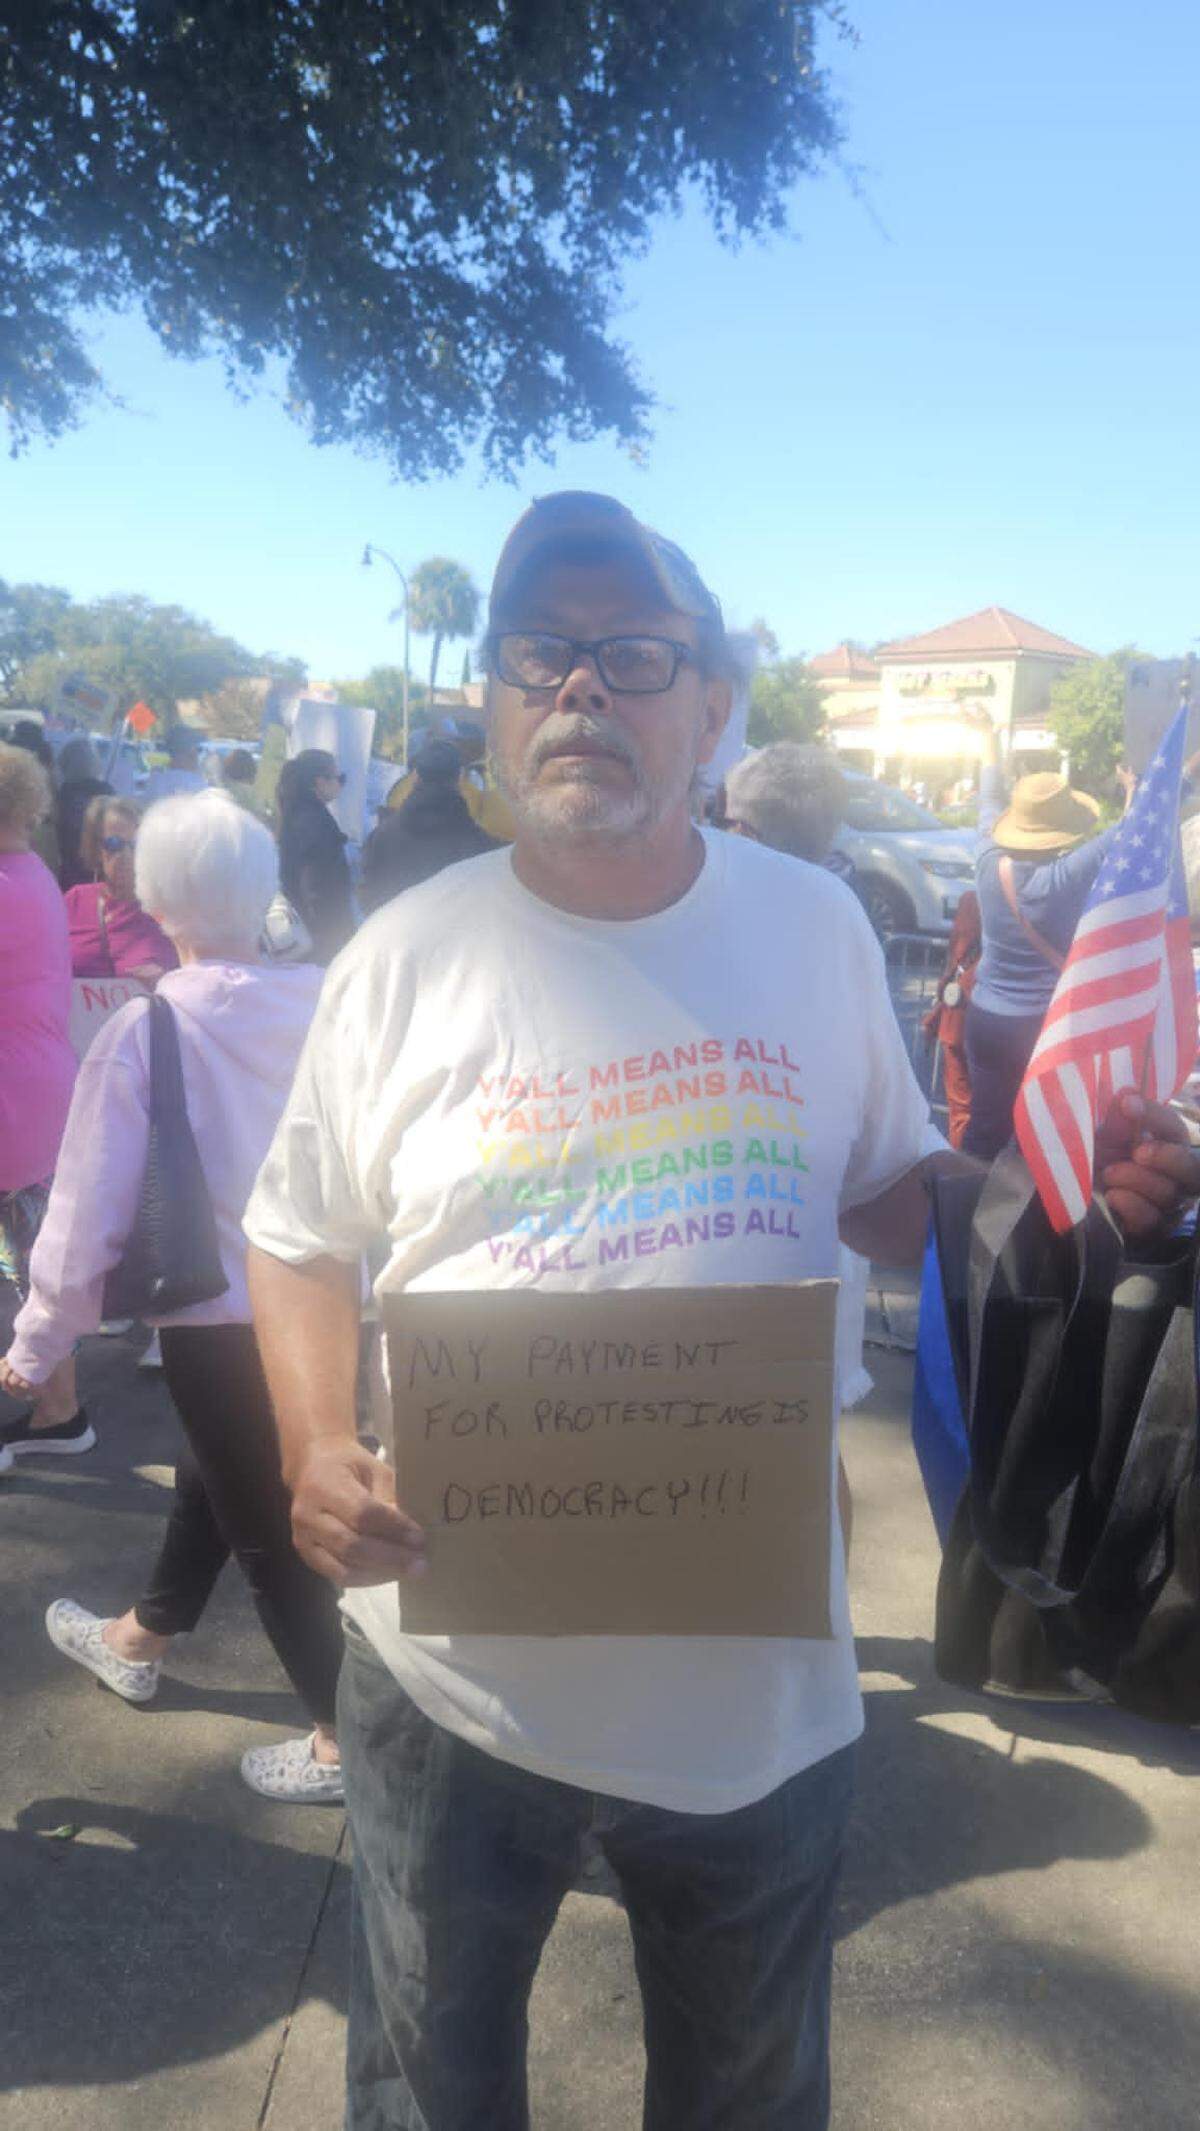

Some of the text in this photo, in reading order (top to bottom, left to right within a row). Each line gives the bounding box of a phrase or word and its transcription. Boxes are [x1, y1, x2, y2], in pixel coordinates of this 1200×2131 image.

[476, 1037, 800, 1100] Y'ALL MEANS ALL
[476, 1069, 804, 1135] Y'ALL MEANS ALL
[594, 1105, 731, 1158] MEANS
[741, 1102, 808, 1137] ALL
[596, 1139, 734, 1195] MEANS
[743, 1139, 810, 1172] ALL
[597, 1175, 736, 1226] MEANS
[745, 1173, 804, 1205] ALL
[487, 1208, 800, 1272] Y'ALL MEANS ALL
[409, 1335, 740, 1391] MY PAYMENT
[424, 1398, 809, 1441] FOR PROTESTING IS
[443, 1469, 749, 1524] DEMOCRACY!!!
